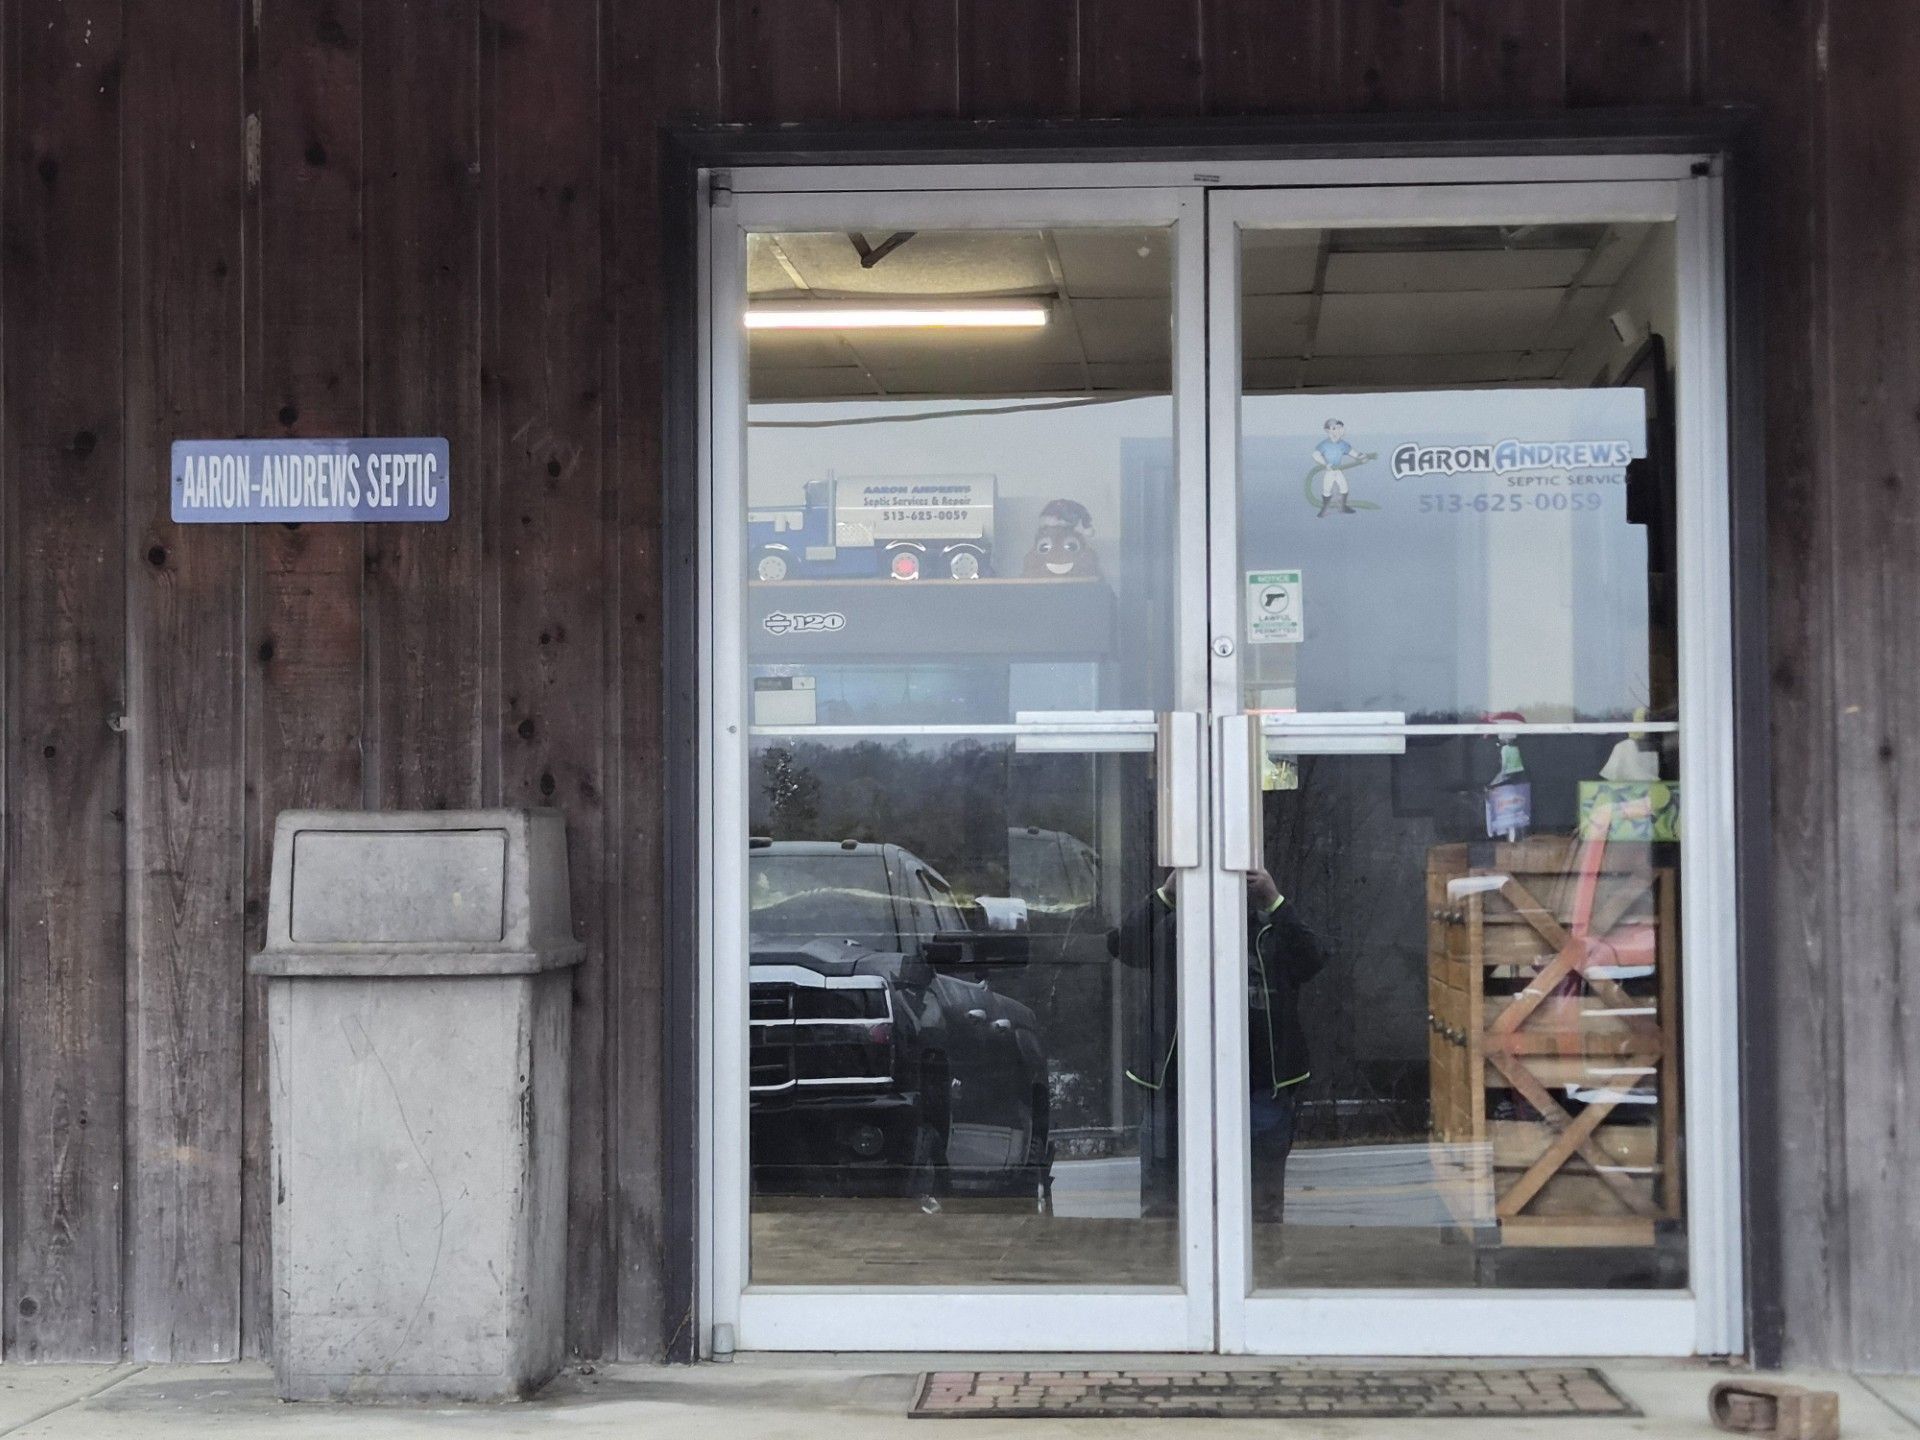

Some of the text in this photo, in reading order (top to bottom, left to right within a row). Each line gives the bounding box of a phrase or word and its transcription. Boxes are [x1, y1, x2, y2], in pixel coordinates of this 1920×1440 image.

[1394, 440, 1628, 475] AARON ANDREWS
[182, 452, 437, 509] AARON-ANDREWS SEPTIC
[1507, 473, 1631, 487] SEPTIC SERVIC
[863, 496, 890, 507] Septic
[892, 496, 929, 506] Services
[931, 496, 939, 506] &
[1418, 492, 1602, 513] 513-625-0059
[883, 510, 968, 521] 513-625-0059
[793, 614, 845, 631] 120
